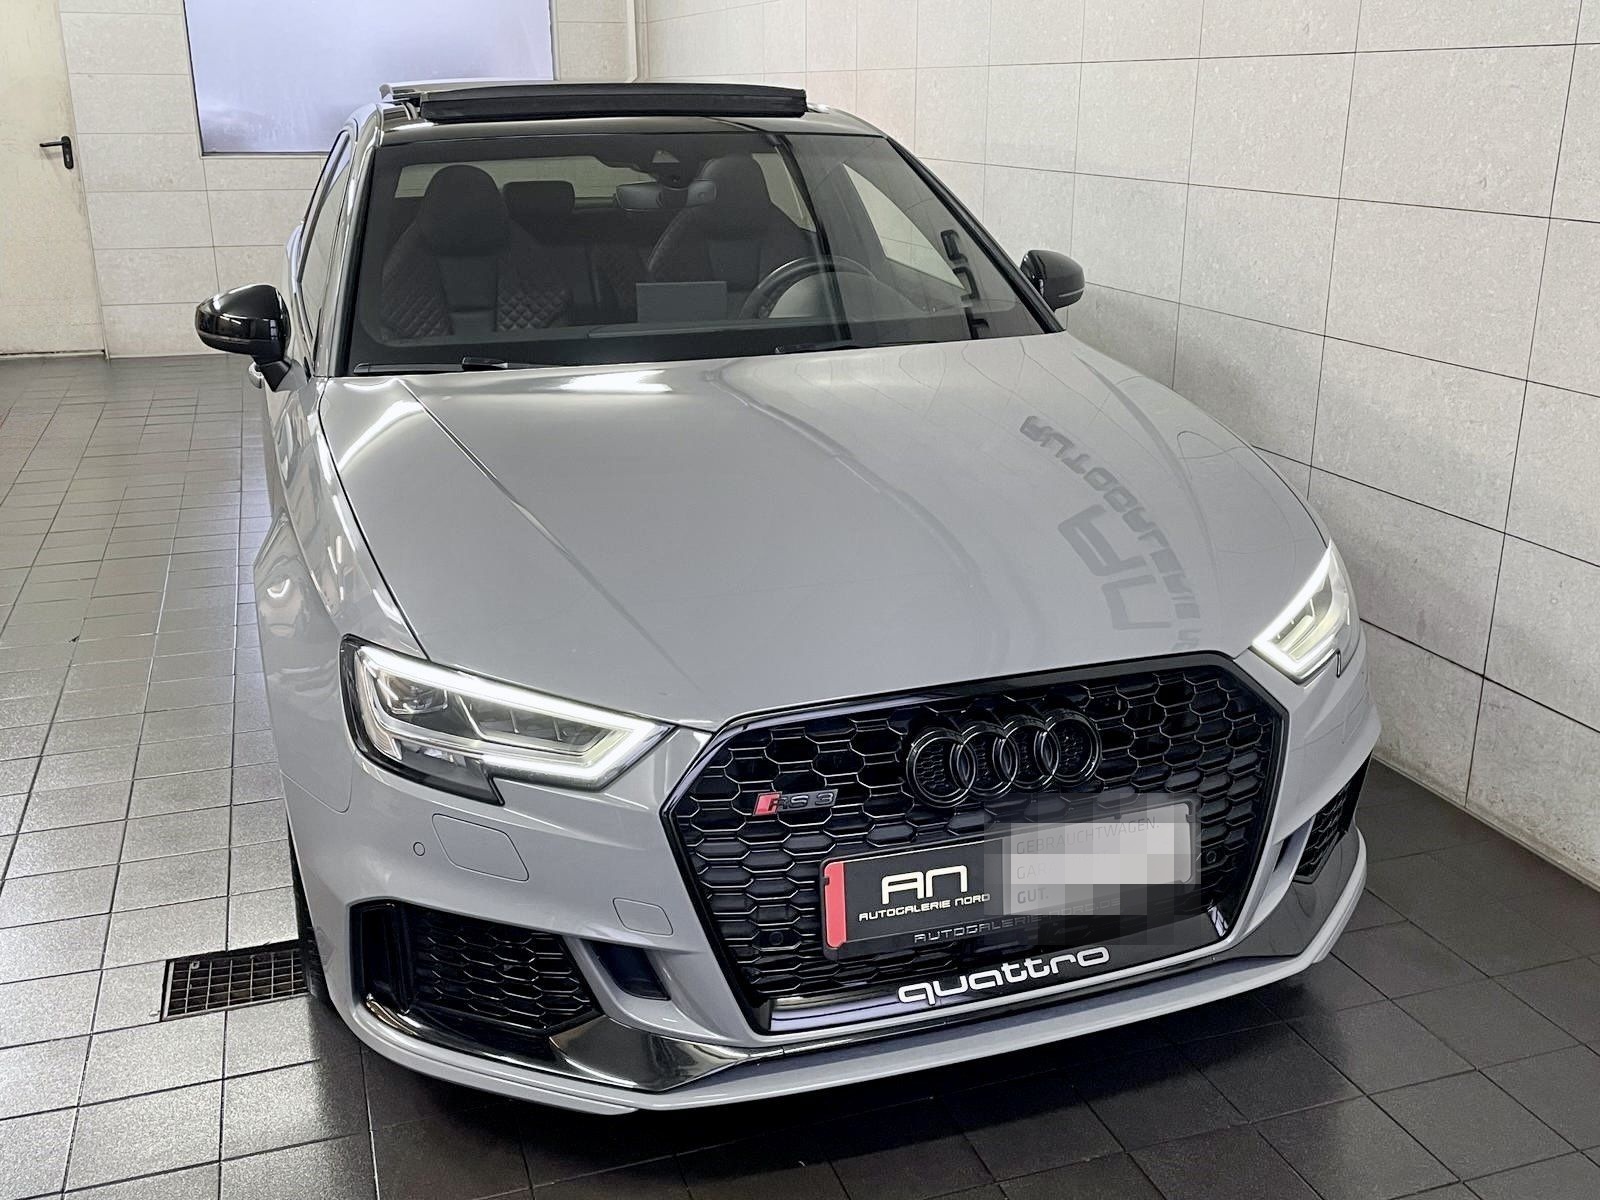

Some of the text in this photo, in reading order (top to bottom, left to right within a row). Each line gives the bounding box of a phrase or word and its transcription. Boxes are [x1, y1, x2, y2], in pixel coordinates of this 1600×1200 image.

[815, 792, 834, 806] 3
[858, 893, 991, 921] AUTOGALERIE NORD
[898, 946, 1110, 1005] quattro
